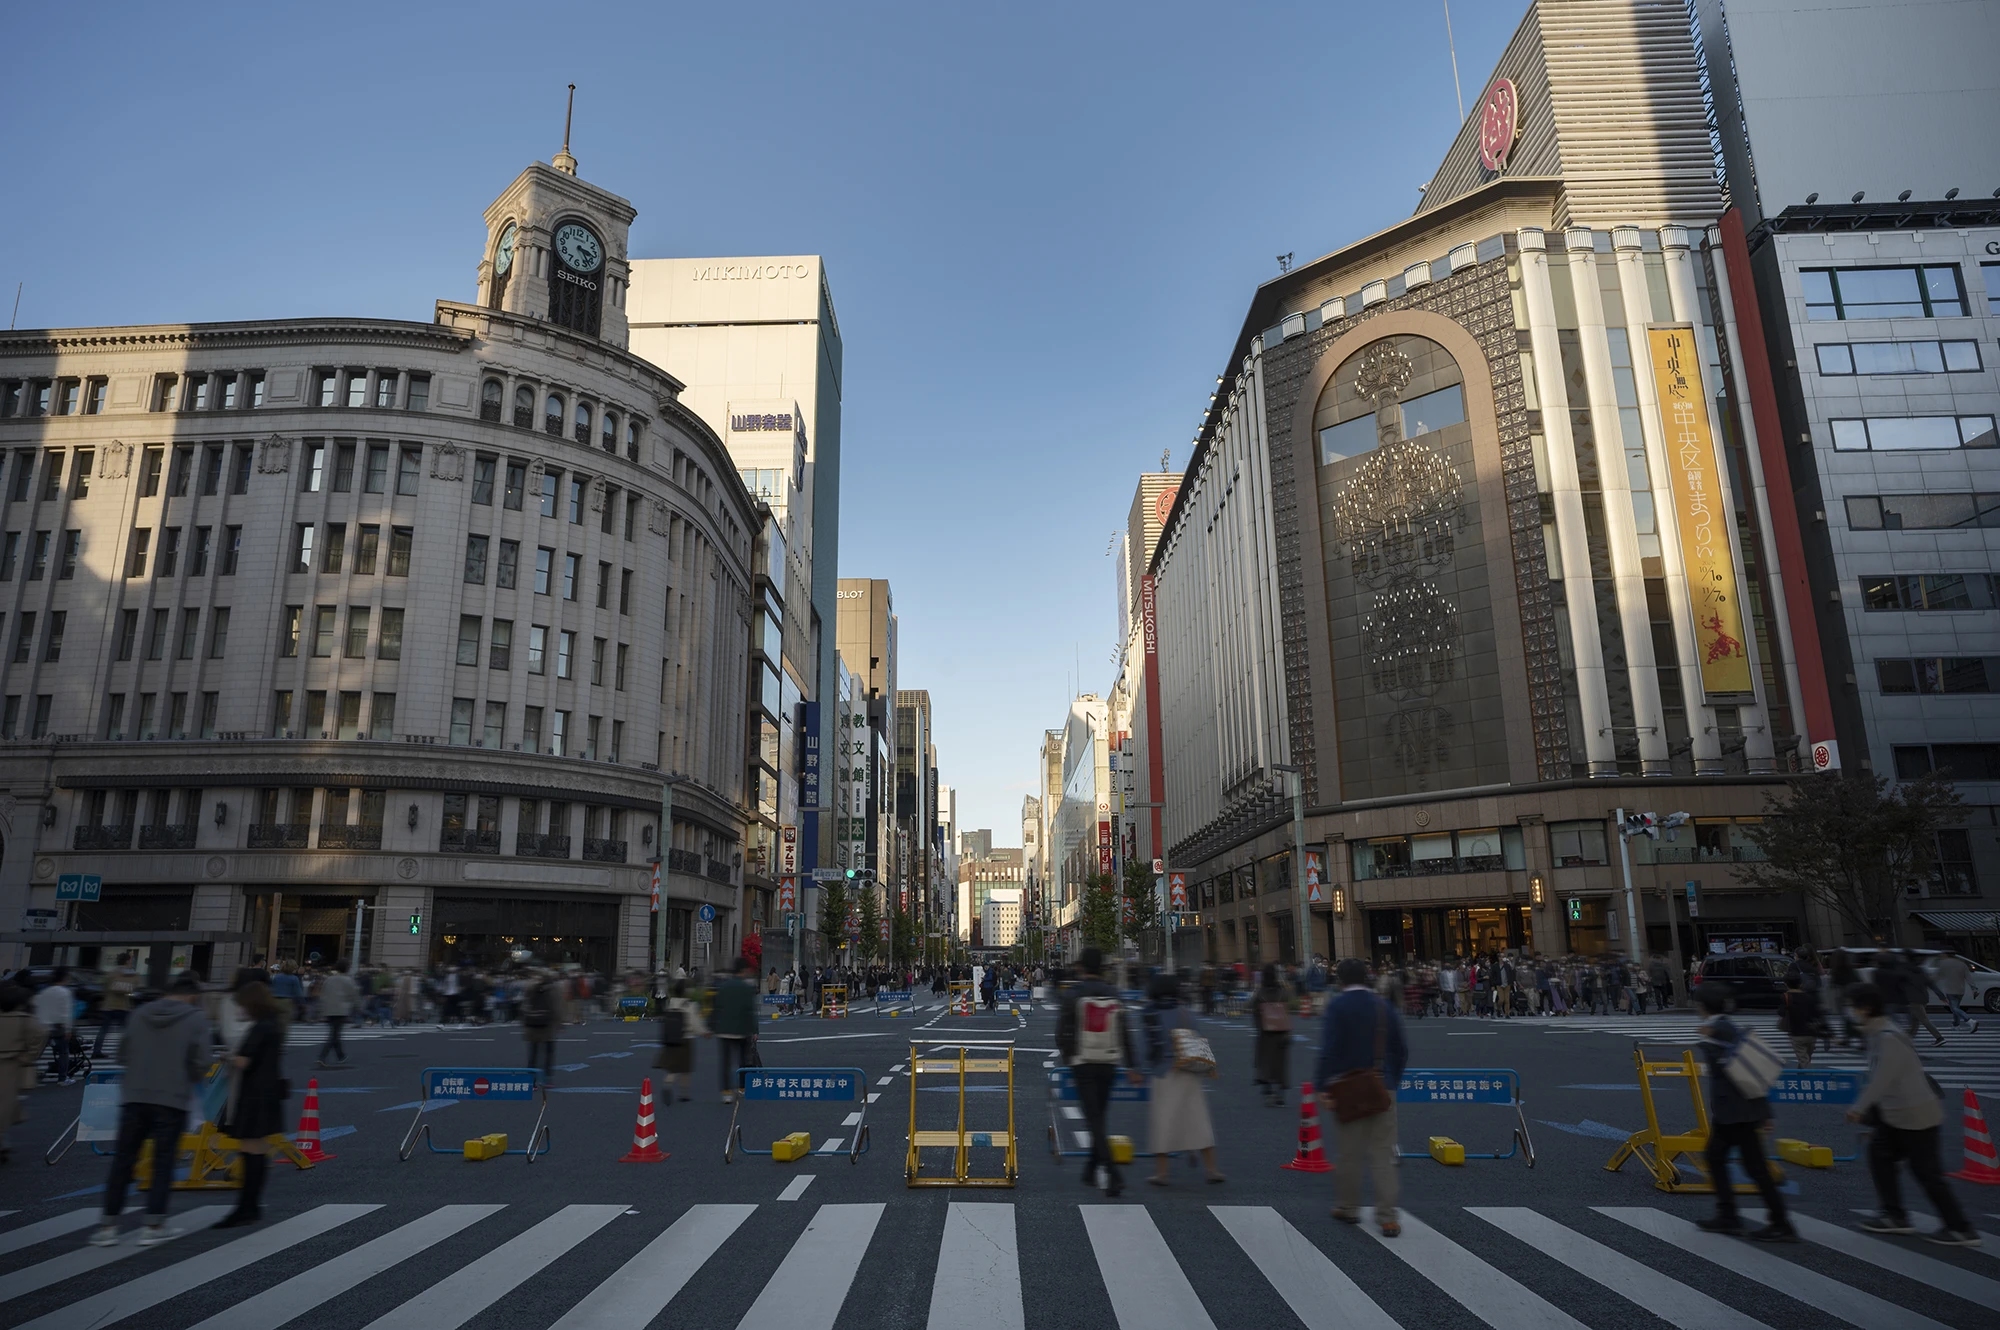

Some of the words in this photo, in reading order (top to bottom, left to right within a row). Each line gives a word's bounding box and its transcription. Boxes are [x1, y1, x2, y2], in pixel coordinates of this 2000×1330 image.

[577, 229, 584, 238] 12
[560, 237, 566, 245] 9
[562, 246, 568, 254] 8
[1986, 241, 2000, 255] G
[568, 253, 574, 262] 7
[574, 259, 580, 267] 6
[692, 264, 809, 281] MIKIMOTO
[557, 269, 597, 291] SEIKO
[731, 413, 793, 432] 山野楽器
[1674, 409, 1705, 471] 中央区
[837, 590, 864, 600] BLOT
[1143, 579, 1155, 654] MITSUKOSHI
[852, 713, 865, 783] 教文館
[806, 736, 819, 804] 山野楽器
[852, 821, 864, 837] 本
[442, 1077, 465, 1086] 自転車
[752, 1078, 848, 1088] 歩行者天国実施中
[1400, 1080, 1503, 1091] 歩行者天国実施中
[434, 1085, 471, 1095] 乗入れ禁止
[491, 1082, 530, 1092] 築地警察署
[779, 1090, 820, 1098] 築地警察署
[1430, 1092, 1474, 1100] 築地警察署
